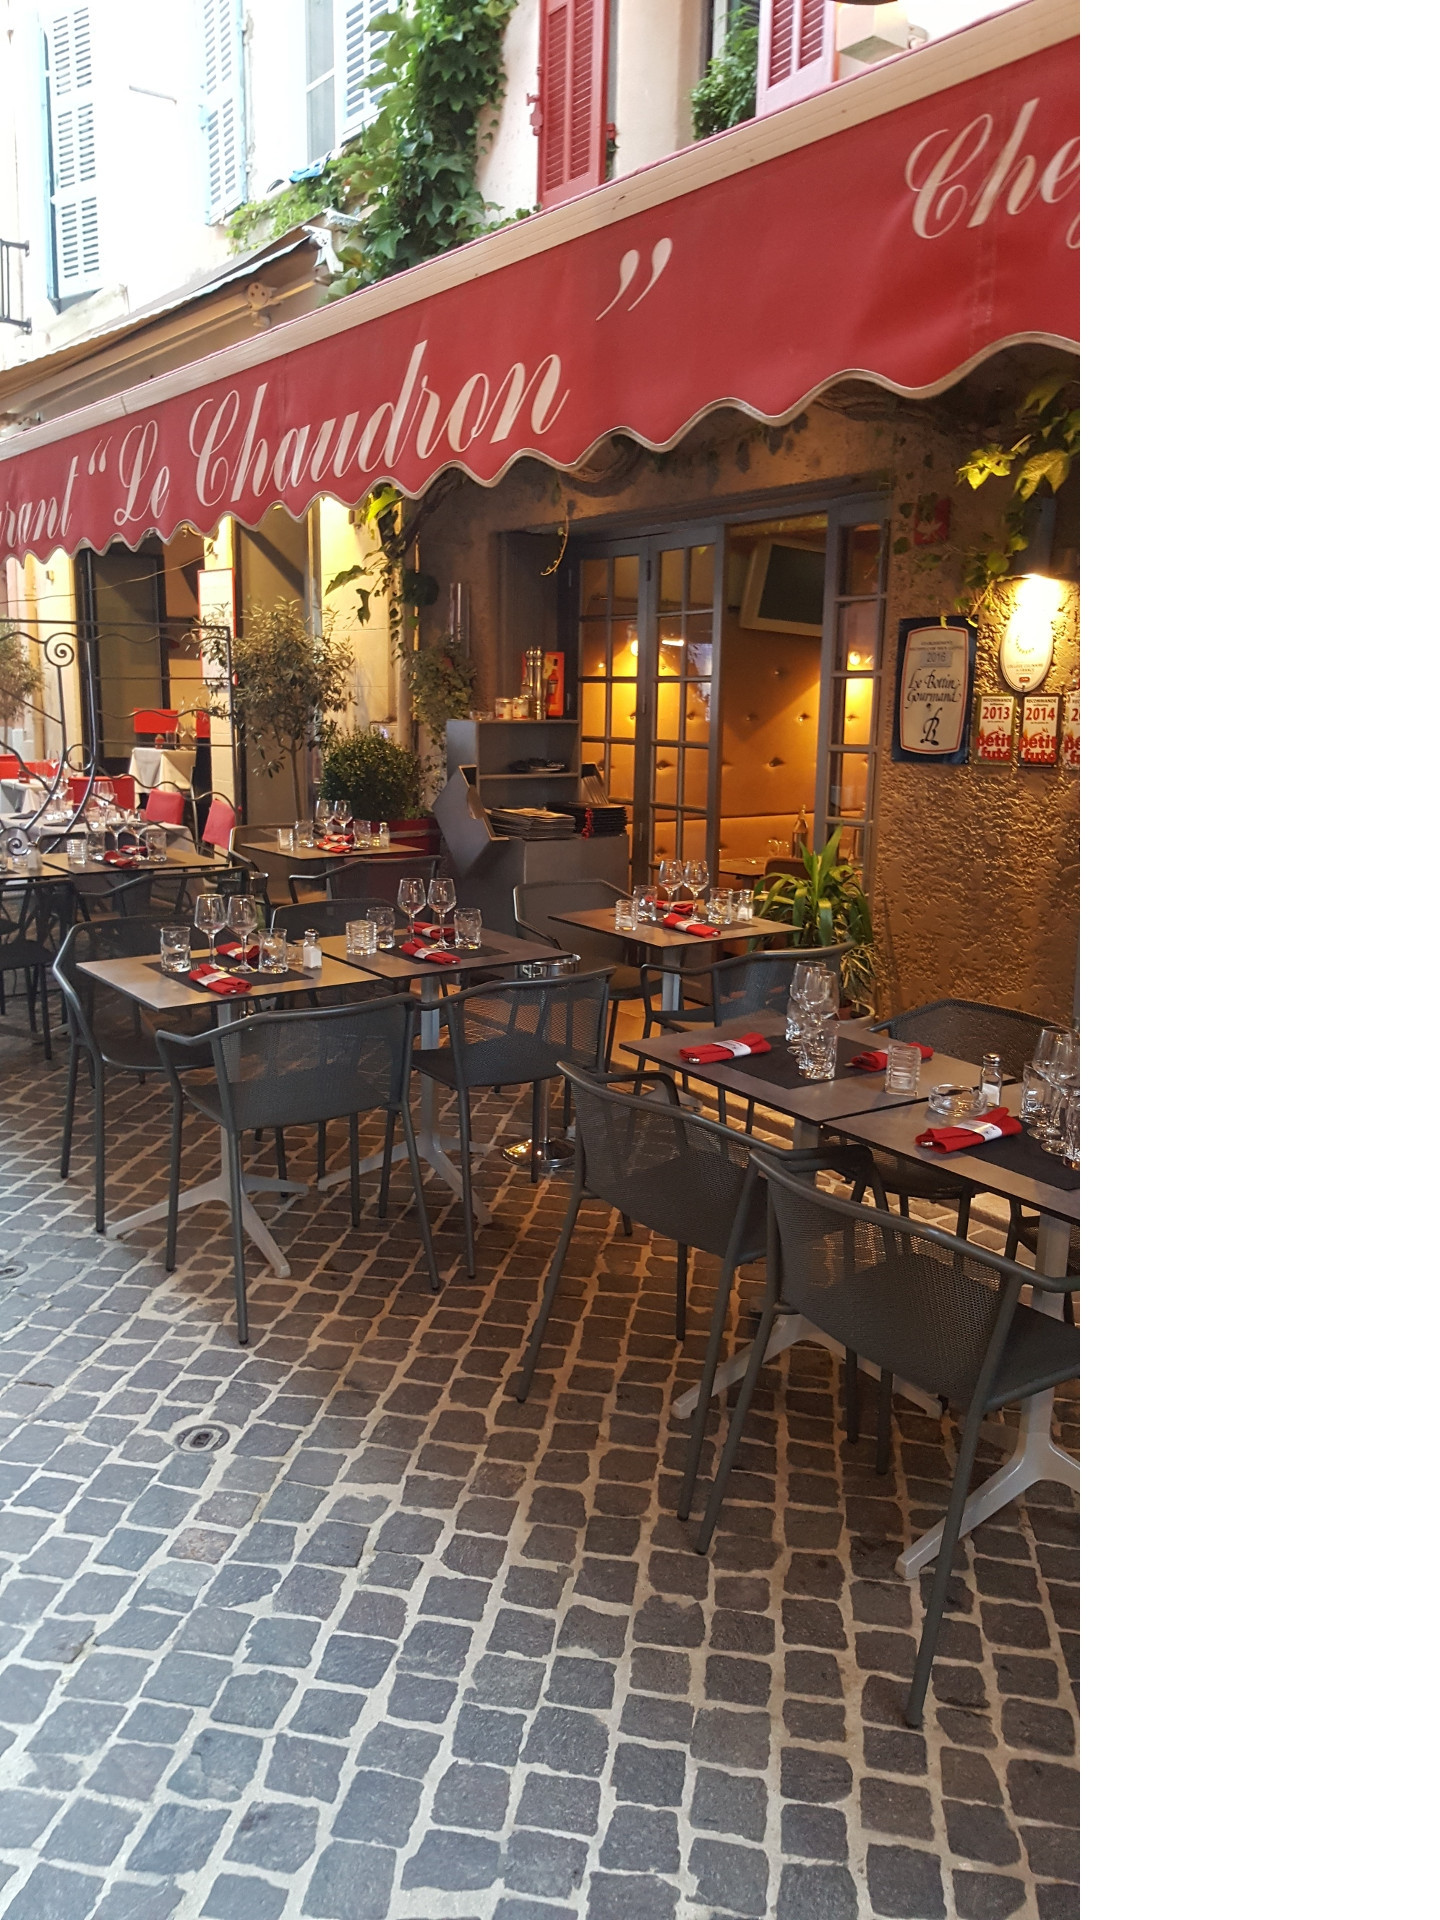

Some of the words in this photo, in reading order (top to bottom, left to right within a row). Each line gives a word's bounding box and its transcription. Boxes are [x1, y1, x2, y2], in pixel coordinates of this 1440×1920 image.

[0, 455, 79, 548] rant
[189, 340, 570, 507] Chaudron
[905, 97, 1080, 249] Che
[927, 652, 947, 663] 2016
[908, 668, 922, 689] Le
[982, 706, 1011, 720] 2013
[1025, 707, 1056, 721] 2014
[976, 732, 1012, 749] petit
[1019, 733, 1057, 752] petit
